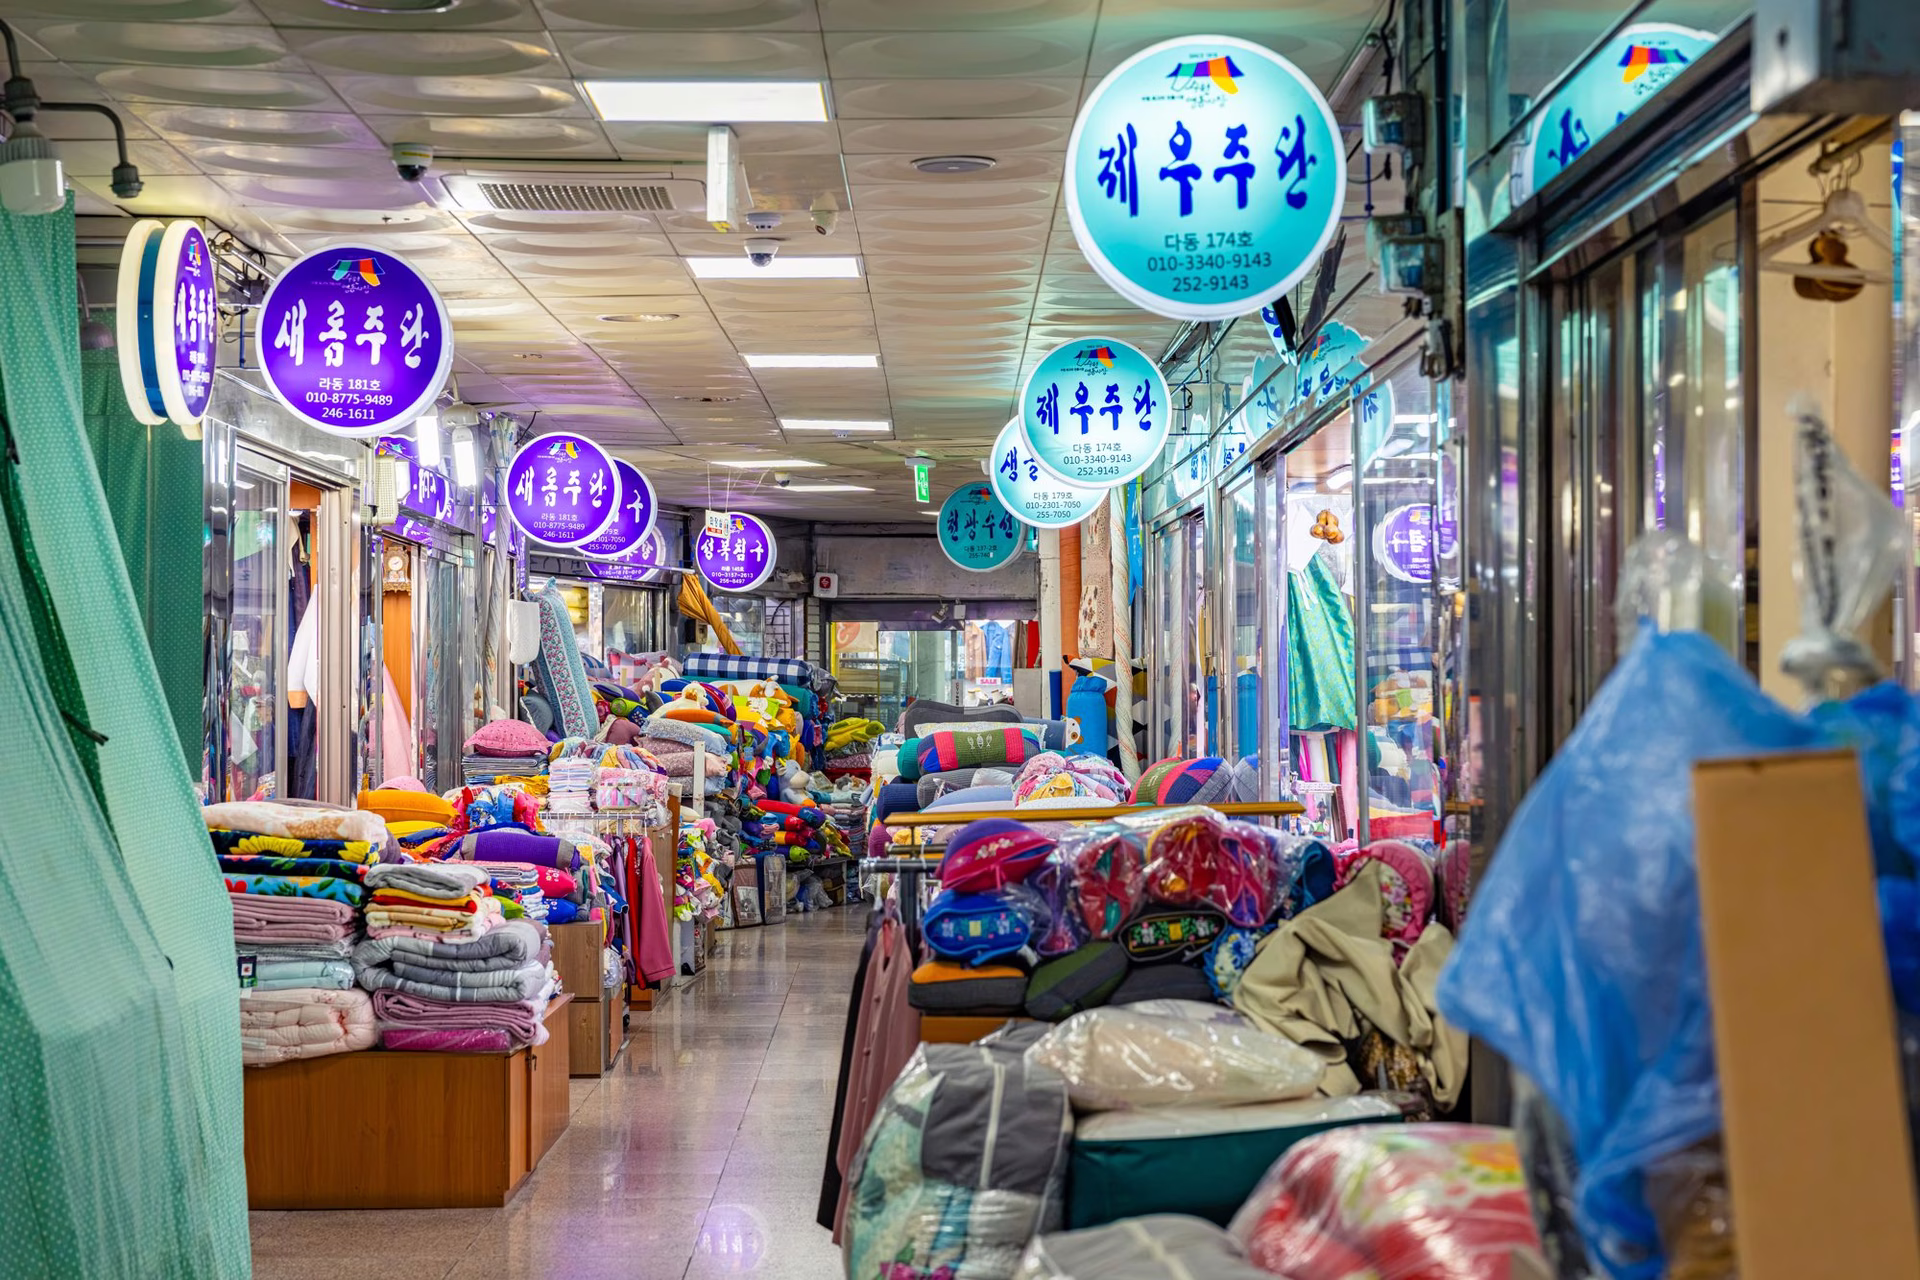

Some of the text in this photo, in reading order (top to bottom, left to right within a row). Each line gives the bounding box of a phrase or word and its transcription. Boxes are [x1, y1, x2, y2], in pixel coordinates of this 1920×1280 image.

[1097, 114, 1317, 217] 제우주단
[1164, 231, 1254, 252] 다동 174호
[1147, 252, 1272, 272] 010-3340-9143
[1172, 274, 1249, 292] 252-9143
[318, 378, 381, 391] 라동 181호
[305, 392, 393, 406] 010-8775-9489
[1036, 379, 1157, 435] 제우주단
[321, 407, 375, 420] 246-1611
[1072, 443, 1122, 453] 다동 174호
[1063, 454, 1132, 465] 010-3340-9143
[1077, 466, 1120, 476] 252-9143
[1033, 492, 1073, 500] 다동 179호
[1025, 501, 1081, 509] 010-2301-7050
[541, 513, 578, 521] 라동 181호
[1036, 511, 1071, 519] 255-7050
[533, 522, 586, 531] 010-8775-9489
[542, 531, 575, 539] 246-1611
